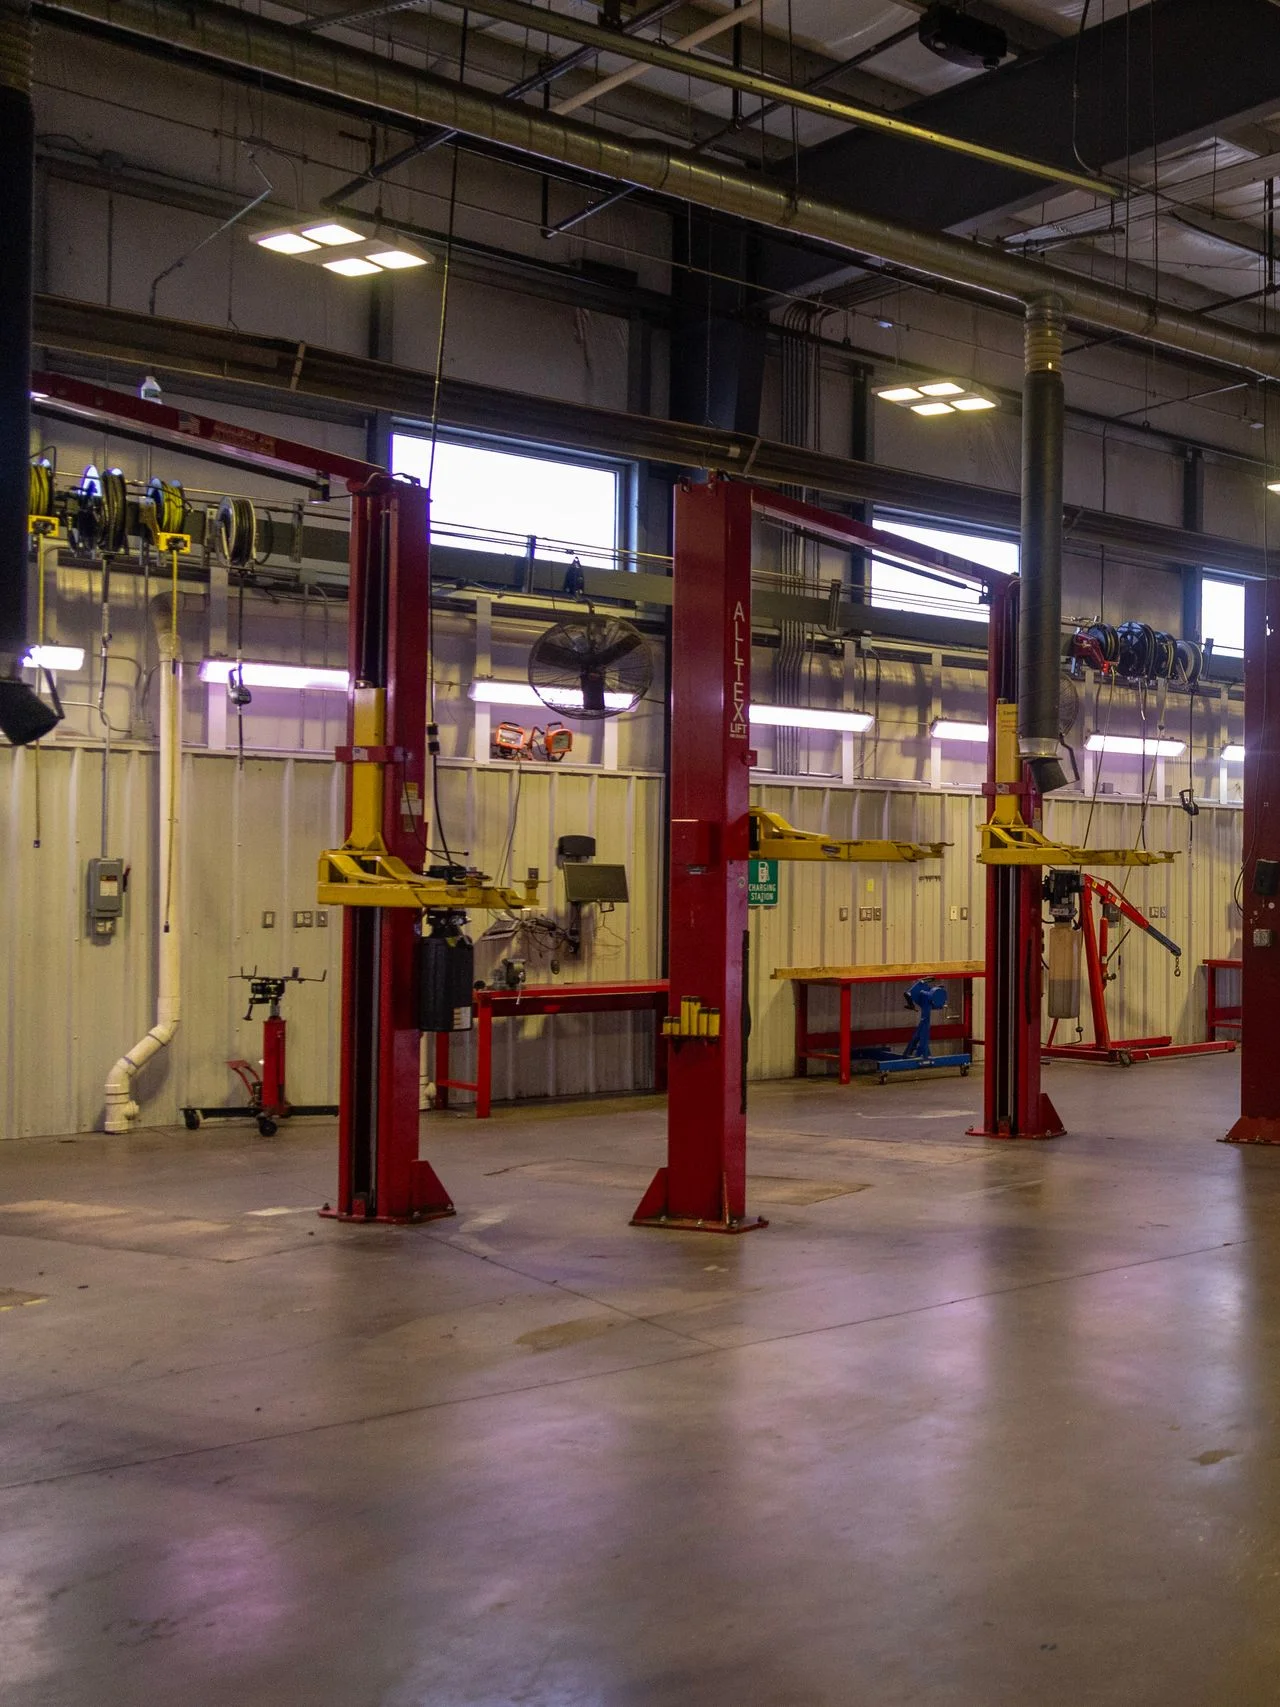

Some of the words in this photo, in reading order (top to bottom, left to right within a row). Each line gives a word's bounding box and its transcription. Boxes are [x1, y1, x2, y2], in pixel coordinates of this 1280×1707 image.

[733, 600, 745, 722] ALLTEX
[730, 722, 747, 734] LIFT
[748, 883, 777, 892] CHARGING
[750, 892, 774, 901] STATION
